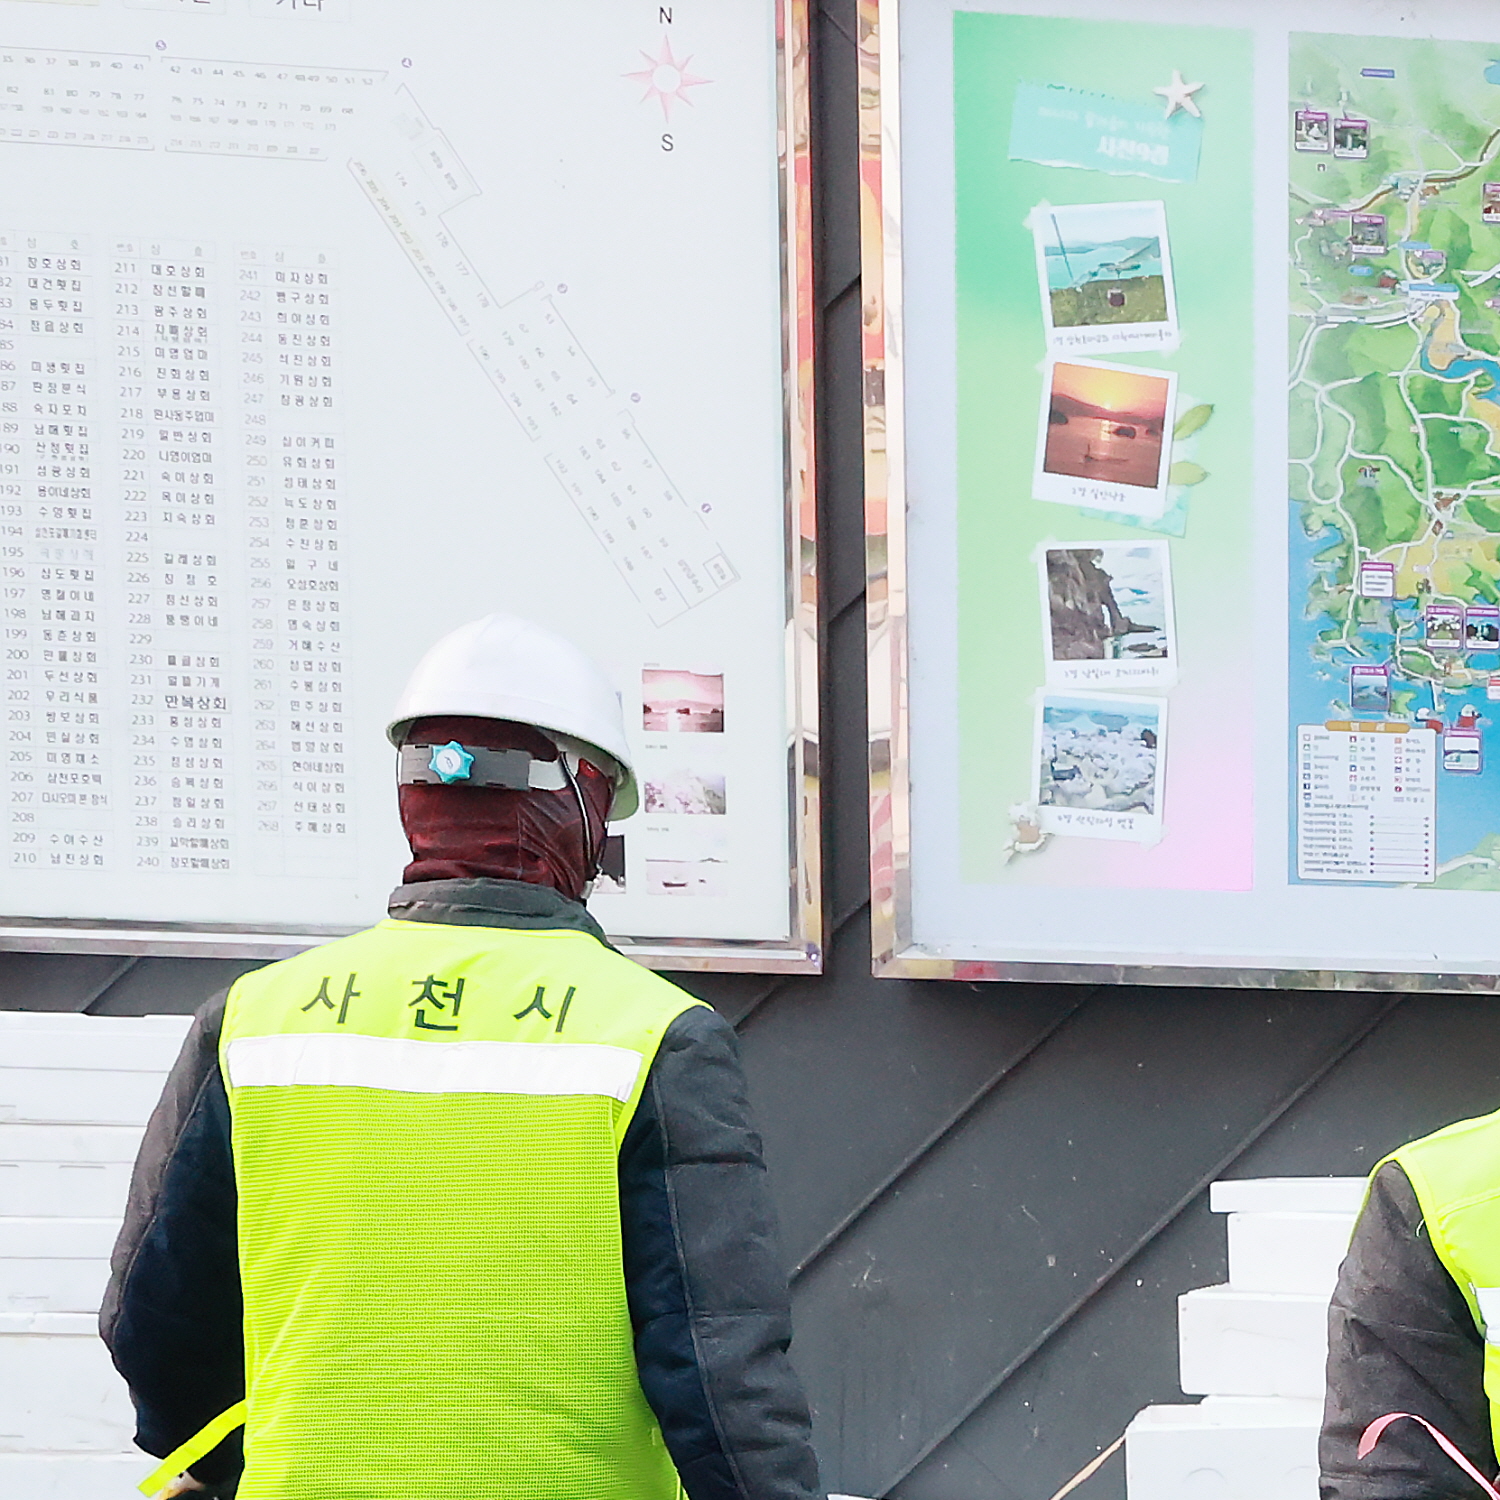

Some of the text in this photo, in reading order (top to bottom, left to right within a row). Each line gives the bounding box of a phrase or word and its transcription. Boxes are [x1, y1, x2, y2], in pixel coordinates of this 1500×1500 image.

[658, 8, 673, 25] N
[661, 134, 675, 152] S
[115, 262, 135, 273] 211
[115, 283, 138, 294] 212
[116, 304, 138, 315] 213
[117, 325, 139, 336] 214
[118, 345, 140, 357] 215
[119, 366, 142, 377] 216
[120, 386, 142, 397] 217
[120, 408, 143, 419] 218
[122, 428, 145, 439] 219
[123, 449, 146, 460] 220
[124, 470, 144, 481] 221
[124, 490, 146, 501] 222
[1, 505, 22, 516] 193
[125, 511, 147, 521] 223
[1, 526, 23, 536] 194
[126, 531, 148, 542] 224
[2, 547, 24, 557] 195
[127, 552, 149, 563] 225
[3, 567, 25, 578] 196
[127, 572, 150, 583] 226
[4, 588, 25, 598] 197
[128, 593, 150, 604] 227
[4, 608, 26, 618] 198
[129, 613, 151, 624] 228
[6, 629, 27, 639] 199
[130, 633, 152, 644] 229
[6, 649, 29, 660] 200
[130, 654, 153, 665] 230
[7, 669, 27, 680] 201
[131, 674, 151, 685] 231
[8, 690, 30, 700] 202
[131, 694, 226, 710] 232 만복상회
[8, 710, 30, 721] 203
[132, 715, 154, 725] 233
[9, 731, 31, 741] 204
[133, 735, 155, 745] 234
[10, 751, 32, 761] 205
[133, 755, 155, 766] 235
[10, 771, 33, 782] 206
[135, 775, 157, 786] 236
[11, 791, 33, 802] 207
[135, 796, 157, 806] 237
[12, 812, 34, 822] 208
[135, 816, 157, 826] 238
[13, 832, 35, 843] 209
[137, 836, 159, 847] 239
[14, 852, 36, 863] 210
[137, 857, 160, 866] 240
[299, 972, 577, 1034] 사천시
